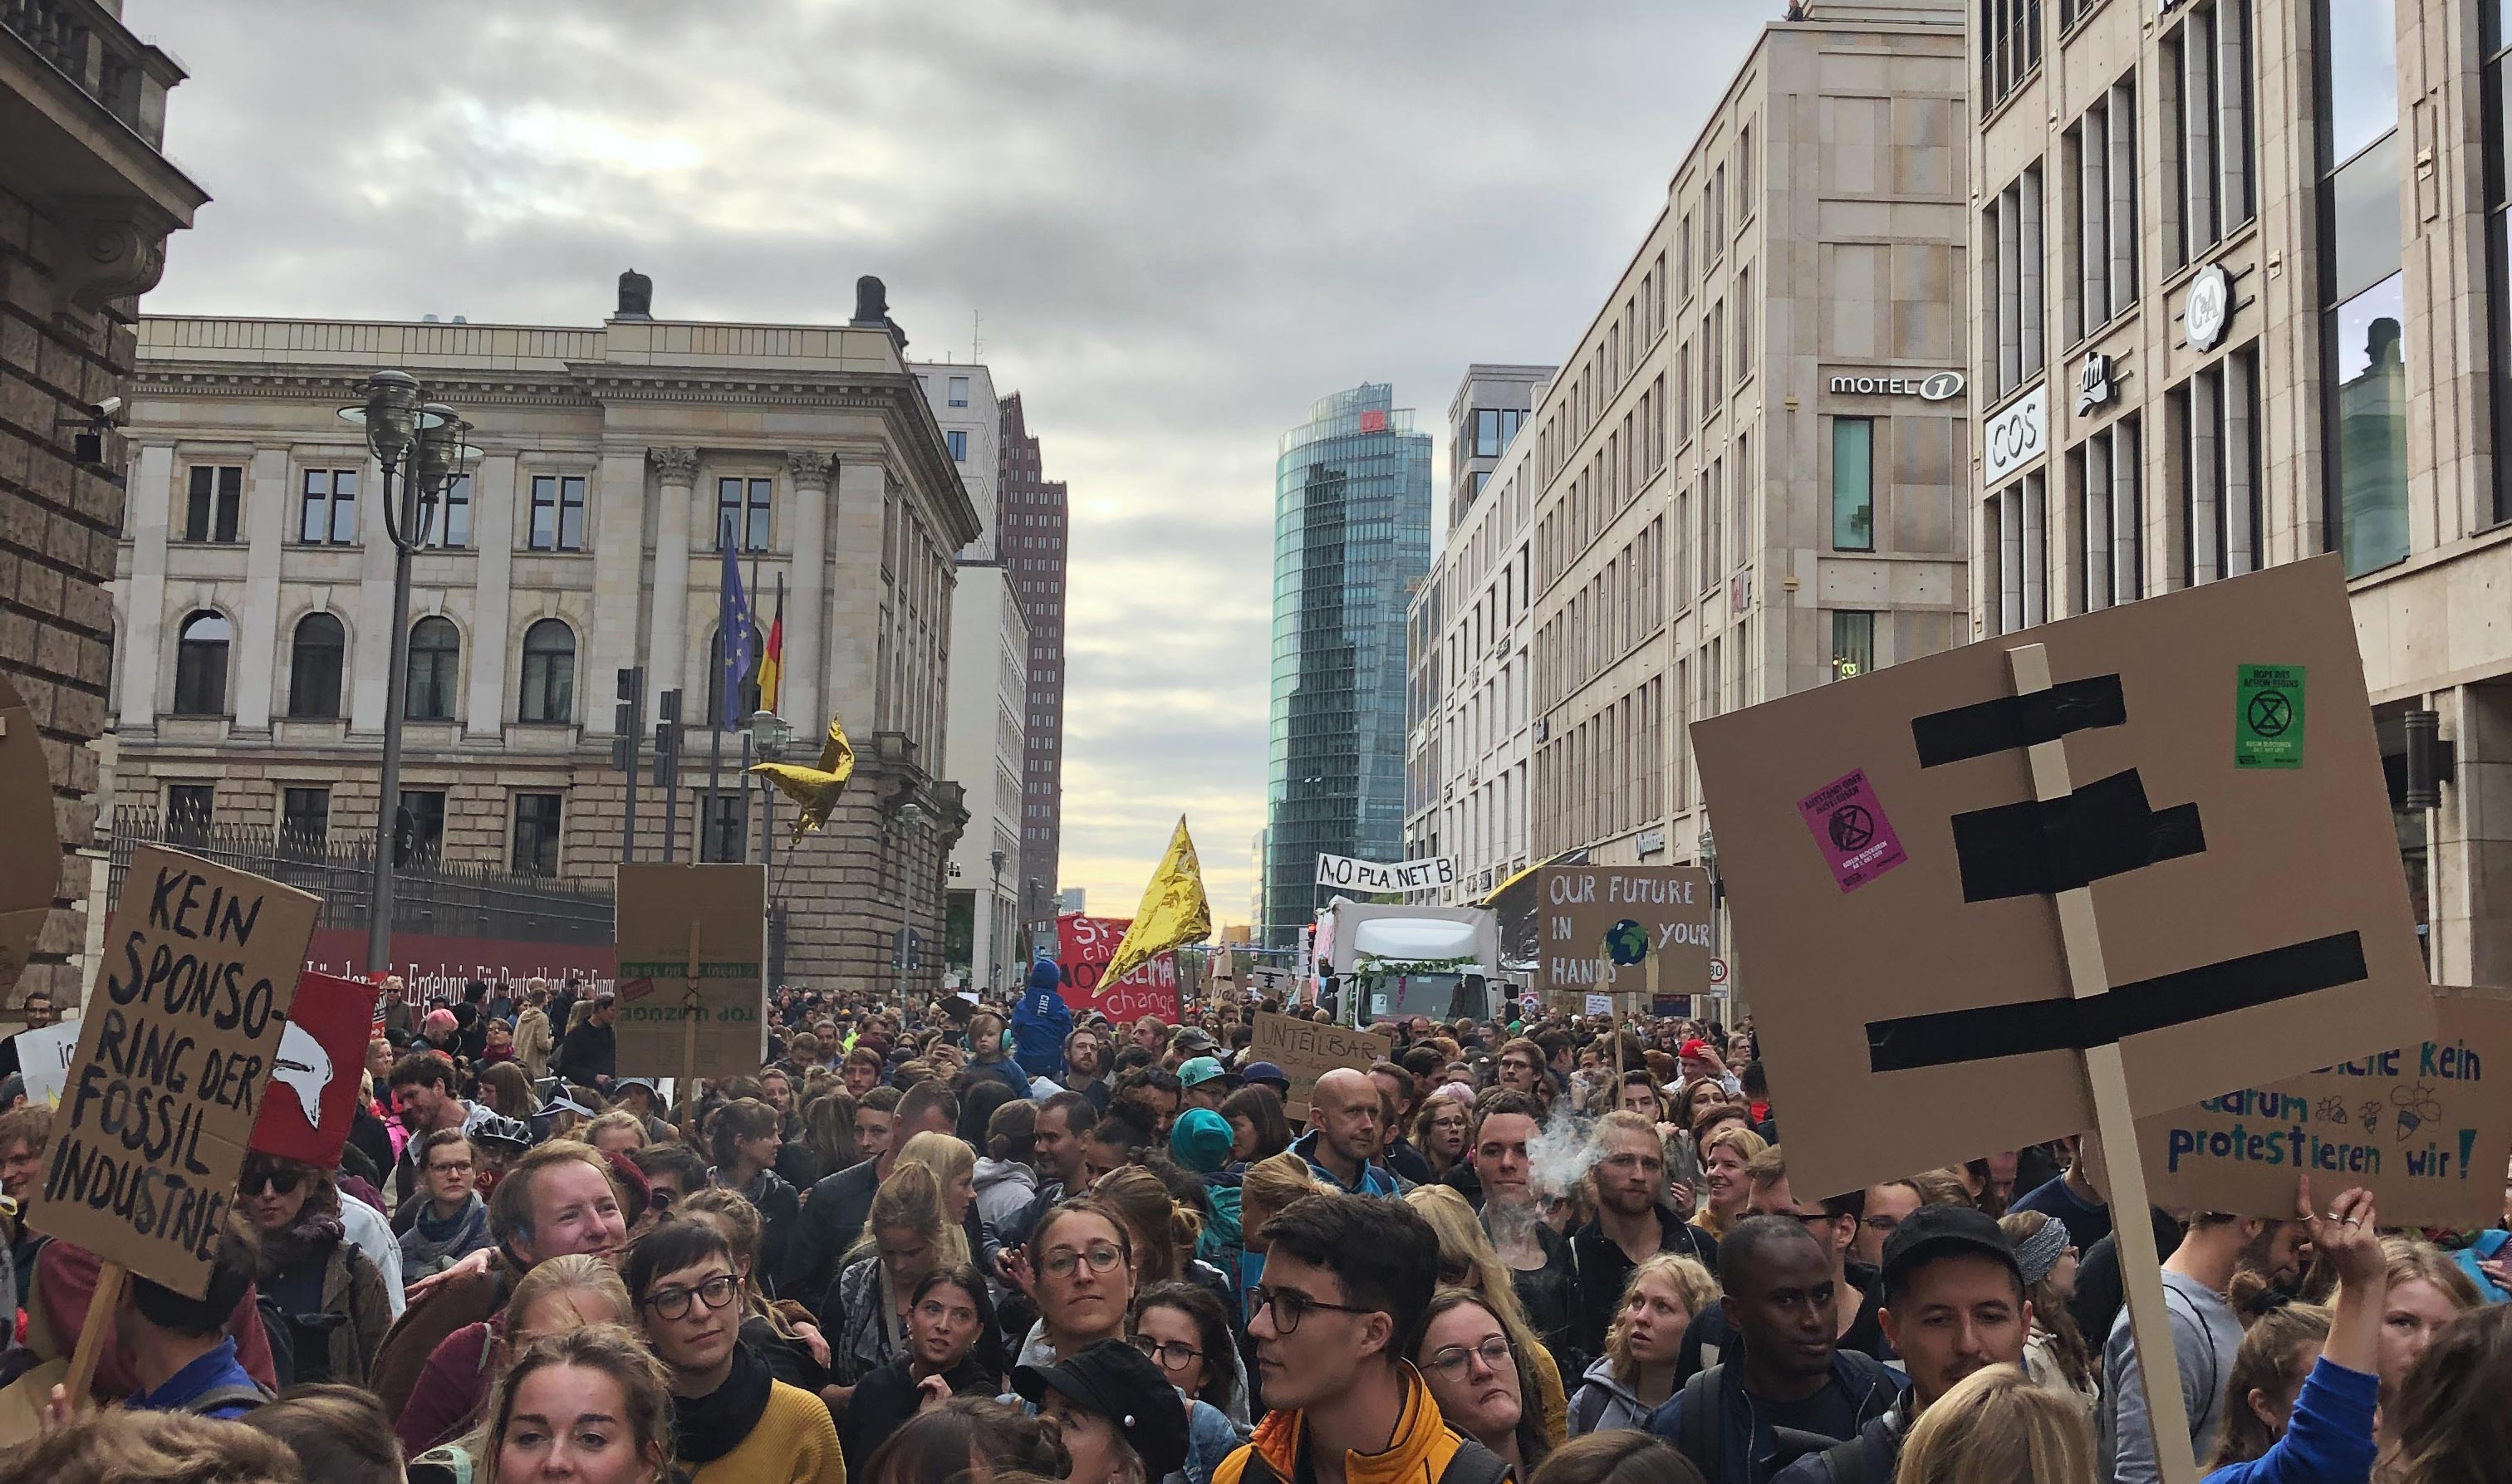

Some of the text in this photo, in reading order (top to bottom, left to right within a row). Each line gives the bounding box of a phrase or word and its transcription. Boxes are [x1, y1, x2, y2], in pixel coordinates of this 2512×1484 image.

[2191, 285, 2220, 330] C&A
[1831, 376, 1917, 395] MOTEL
[2082, 352, 2104, 389] dm
[1993, 404, 2037, 468] COS
[1319, 855, 1352, 884] NO
[1436, 858, 1454, 884] B
[1550, 874, 1695, 905] OUR FUTURE
[150, 866, 264, 947] KEIN
[1552, 916, 1710, 949] IN YOUR
[108, 930, 287, 1039] SPONSO-
[1552, 957, 1617, 985] HANDS
[1106, 990, 1175, 1017] change
[95, 1008, 262, 1116] RING DER
[71, 1063, 210, 1176] FOSSIL
[2168, 1124, 2380, 1173] protestieren
[44, 1134, 223, 1262] INDUSTRIE
